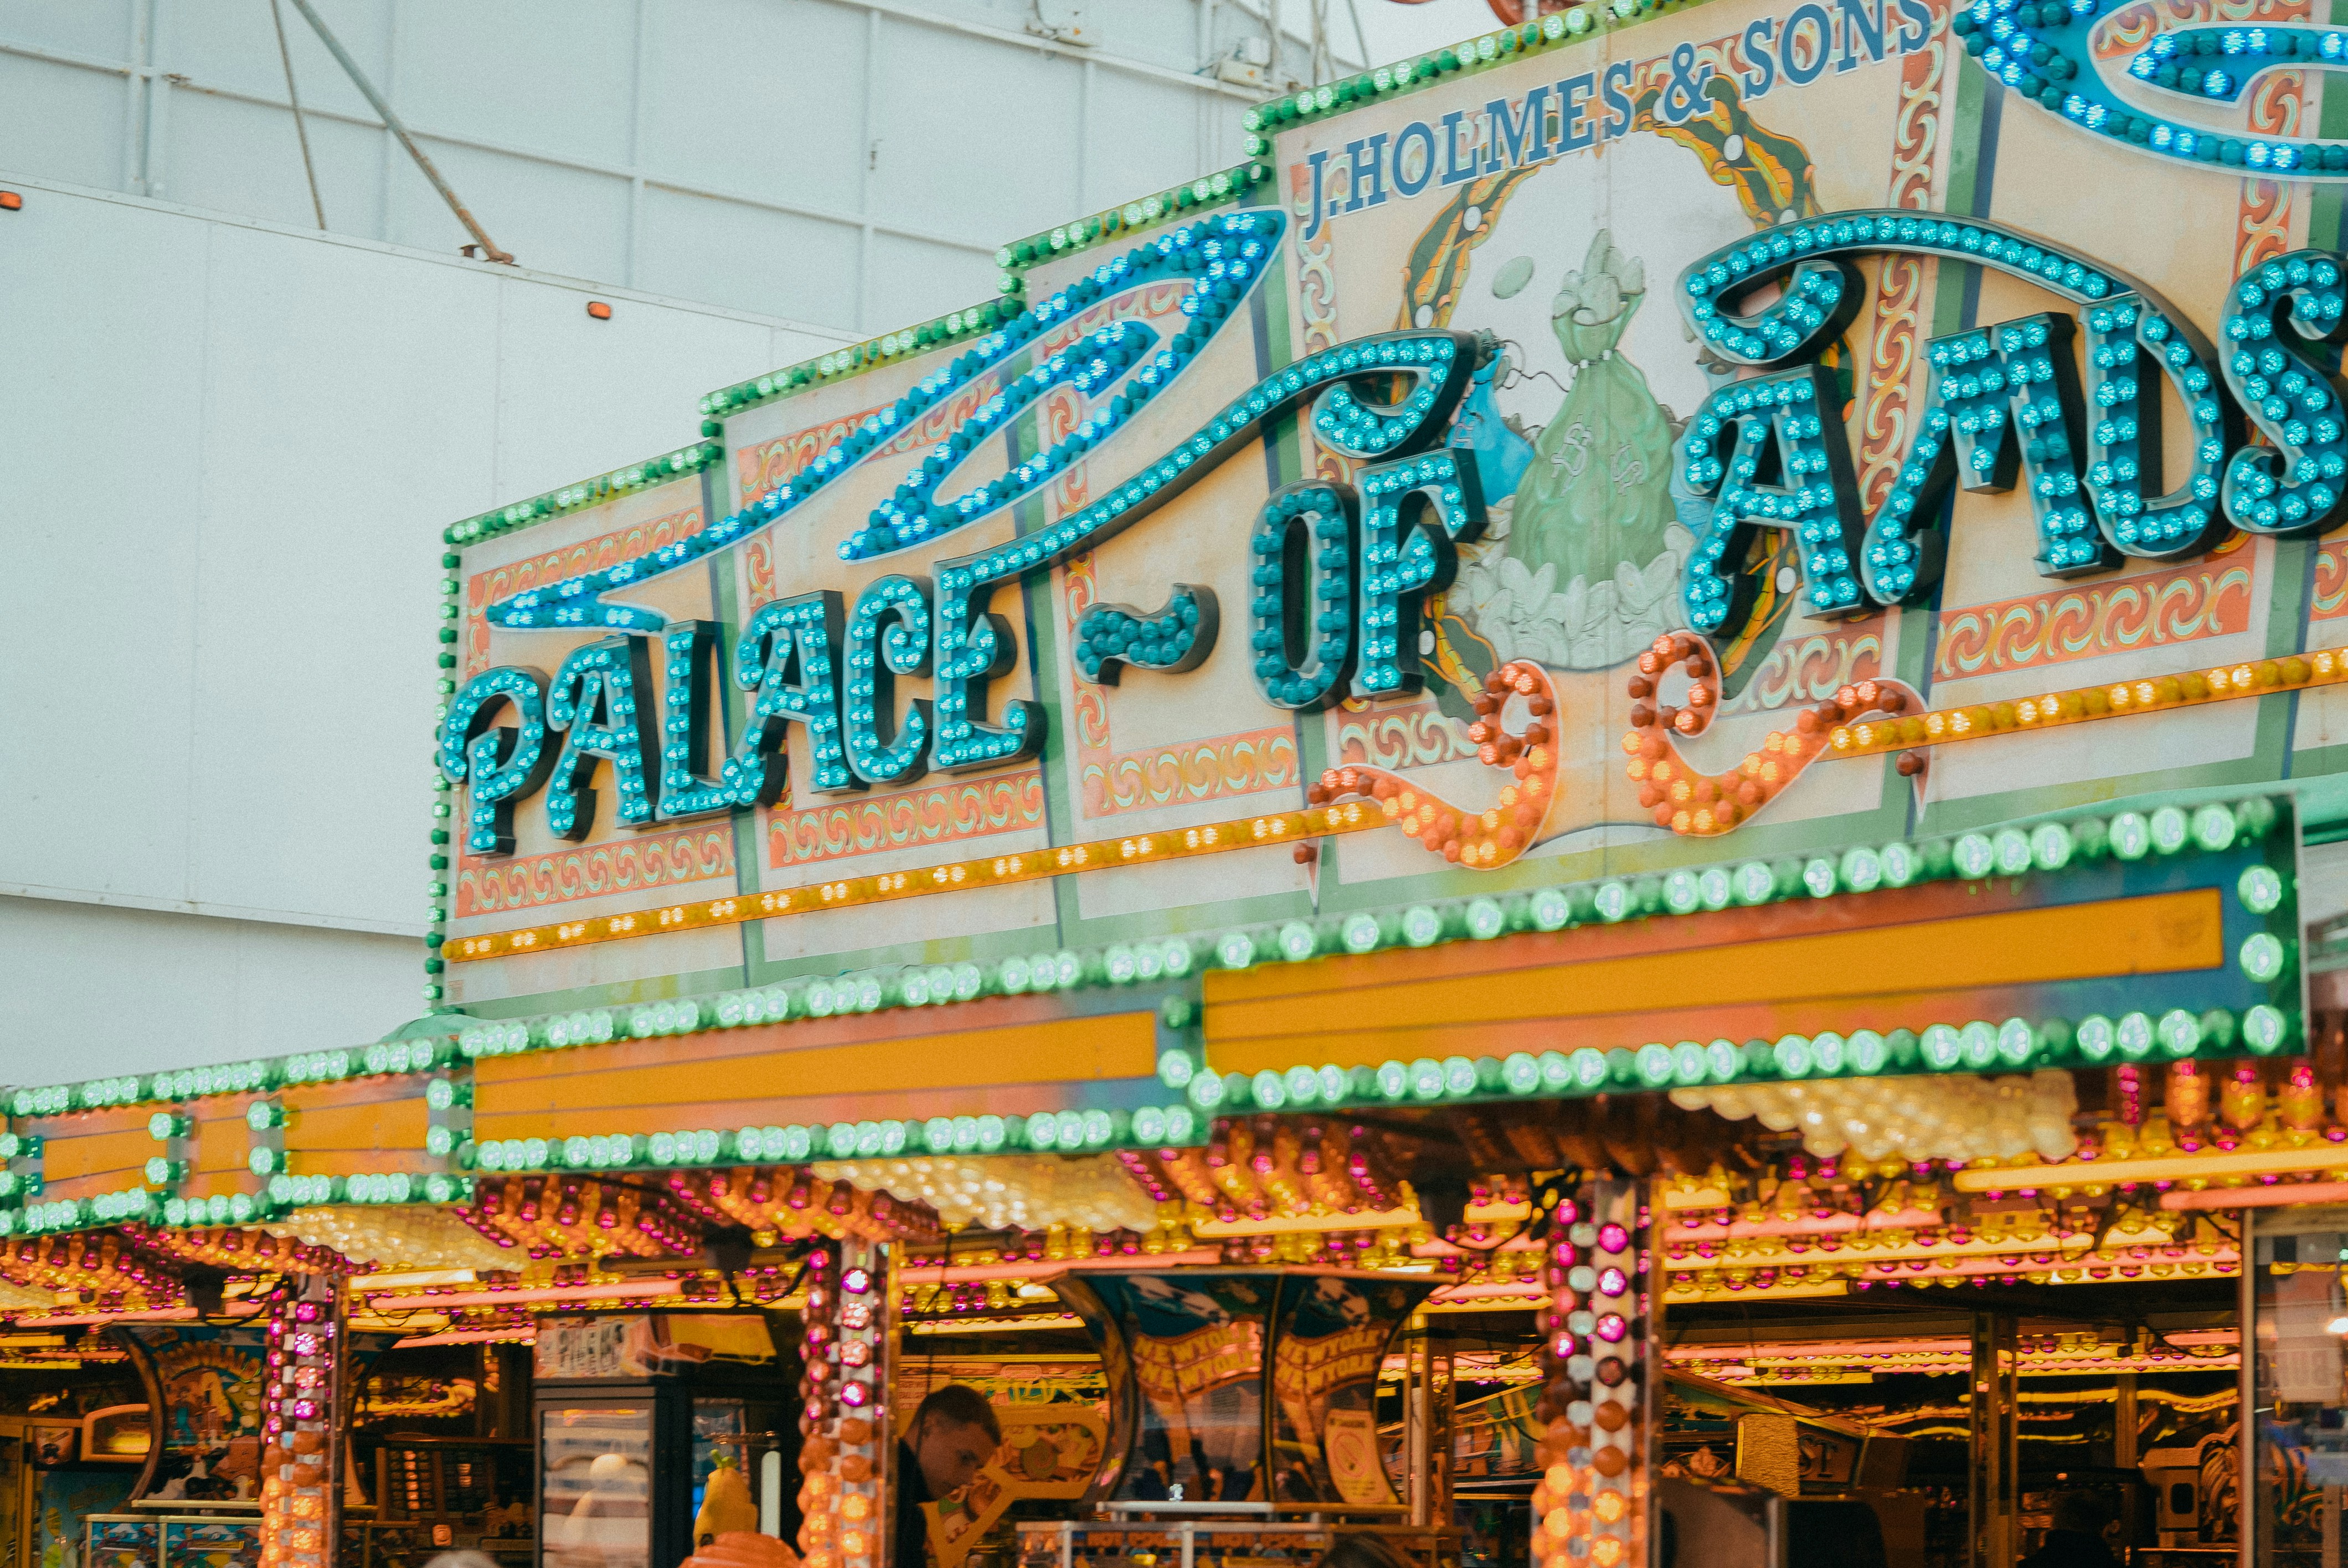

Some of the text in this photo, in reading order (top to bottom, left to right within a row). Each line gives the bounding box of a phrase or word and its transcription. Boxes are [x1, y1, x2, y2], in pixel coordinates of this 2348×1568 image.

[1302, 0, 1933, 241] J.HOLMES & SONS
[446, 558, 1048, 857] PALACE
[1248, 450, 1486, 710] OF
